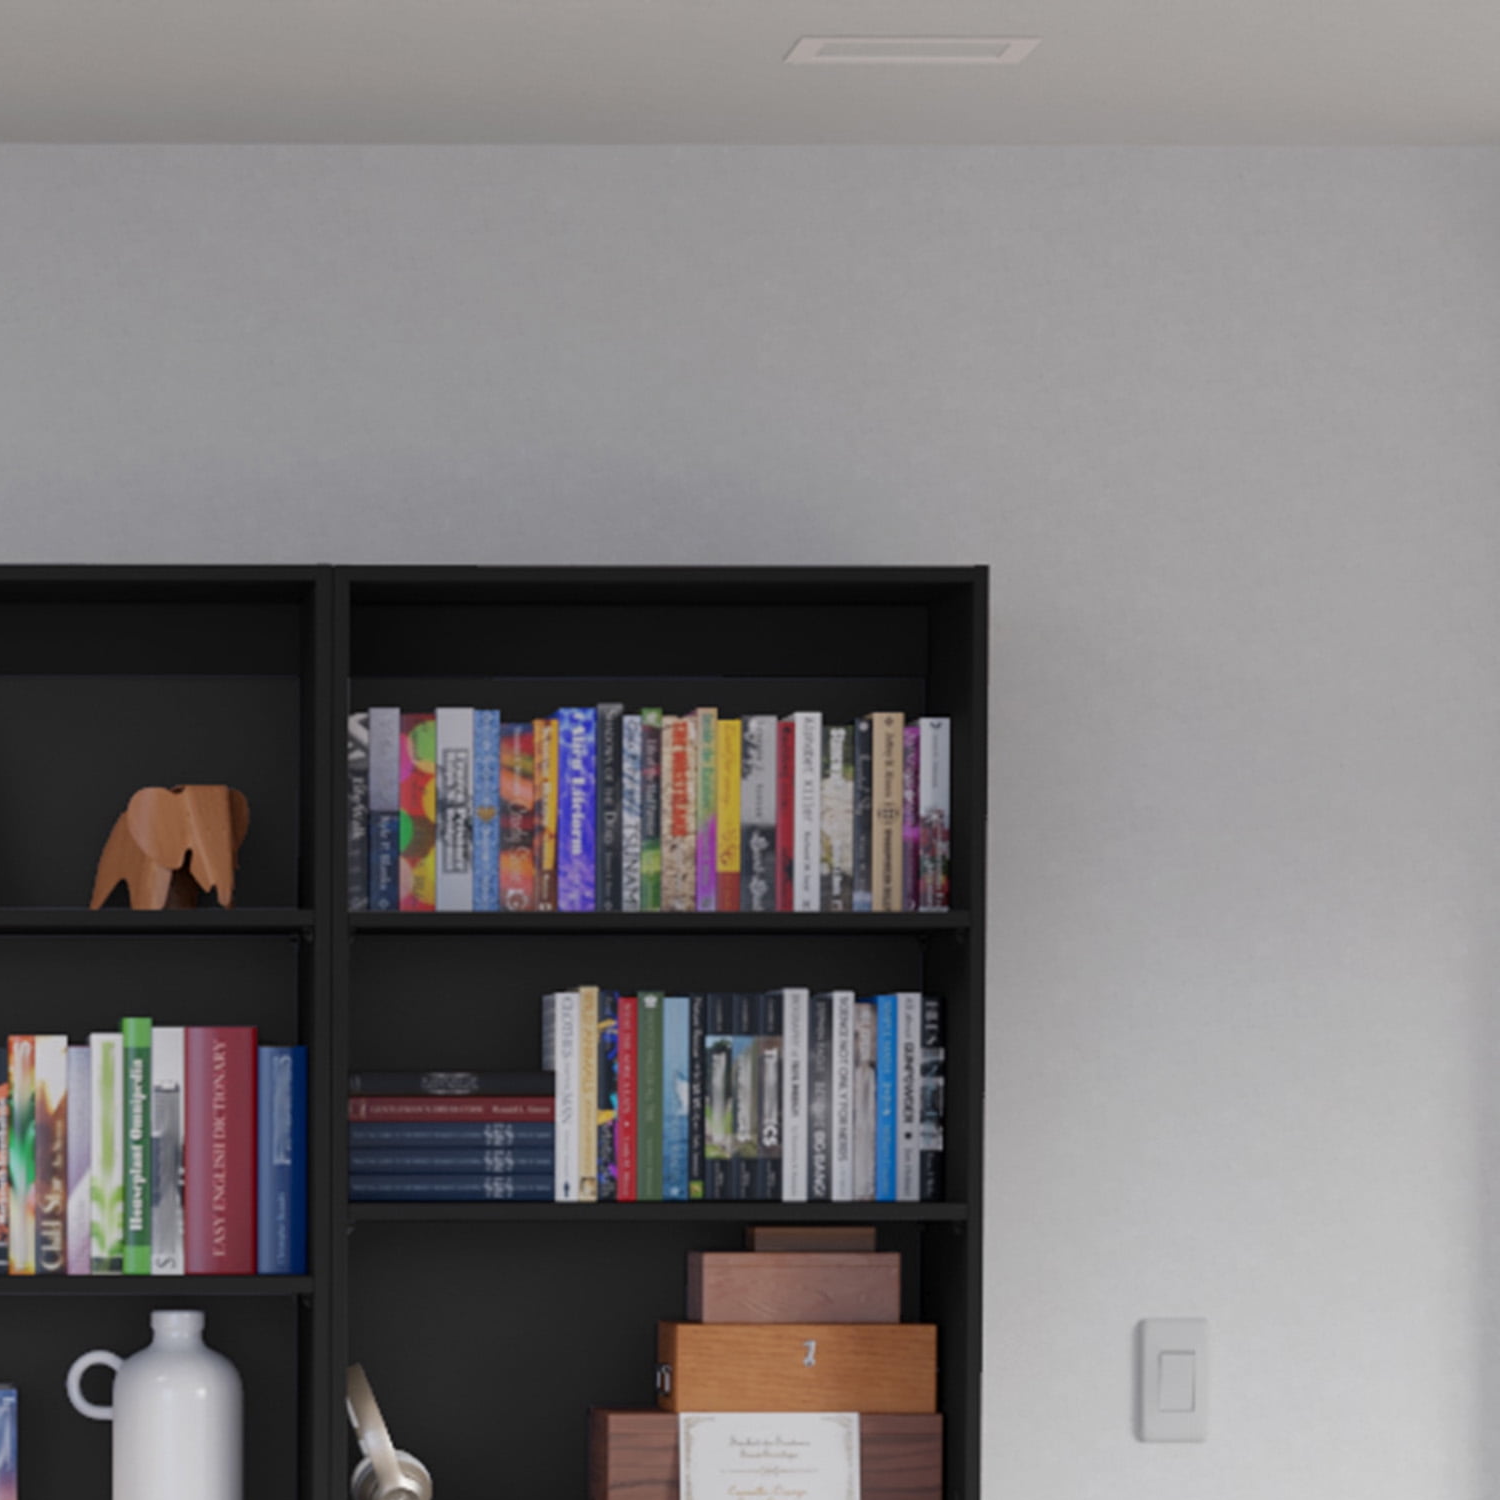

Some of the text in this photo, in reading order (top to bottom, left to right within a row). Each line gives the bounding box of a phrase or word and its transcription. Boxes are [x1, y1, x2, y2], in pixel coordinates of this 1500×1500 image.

[803, 717, 814, 773] Alphabet
[839, 997, 848, 1161] SCIENCE NOT ONLY FOR NERDS
[904, 1042, 914, 1123] GUNPOWDER
[128, 1059, 148, 1231] Houseplant Omnipedia
[212, 1040, 227, 1257] EASY ENGLISH DICTIONARY
[814, 1130, 826, 1151] BIG
